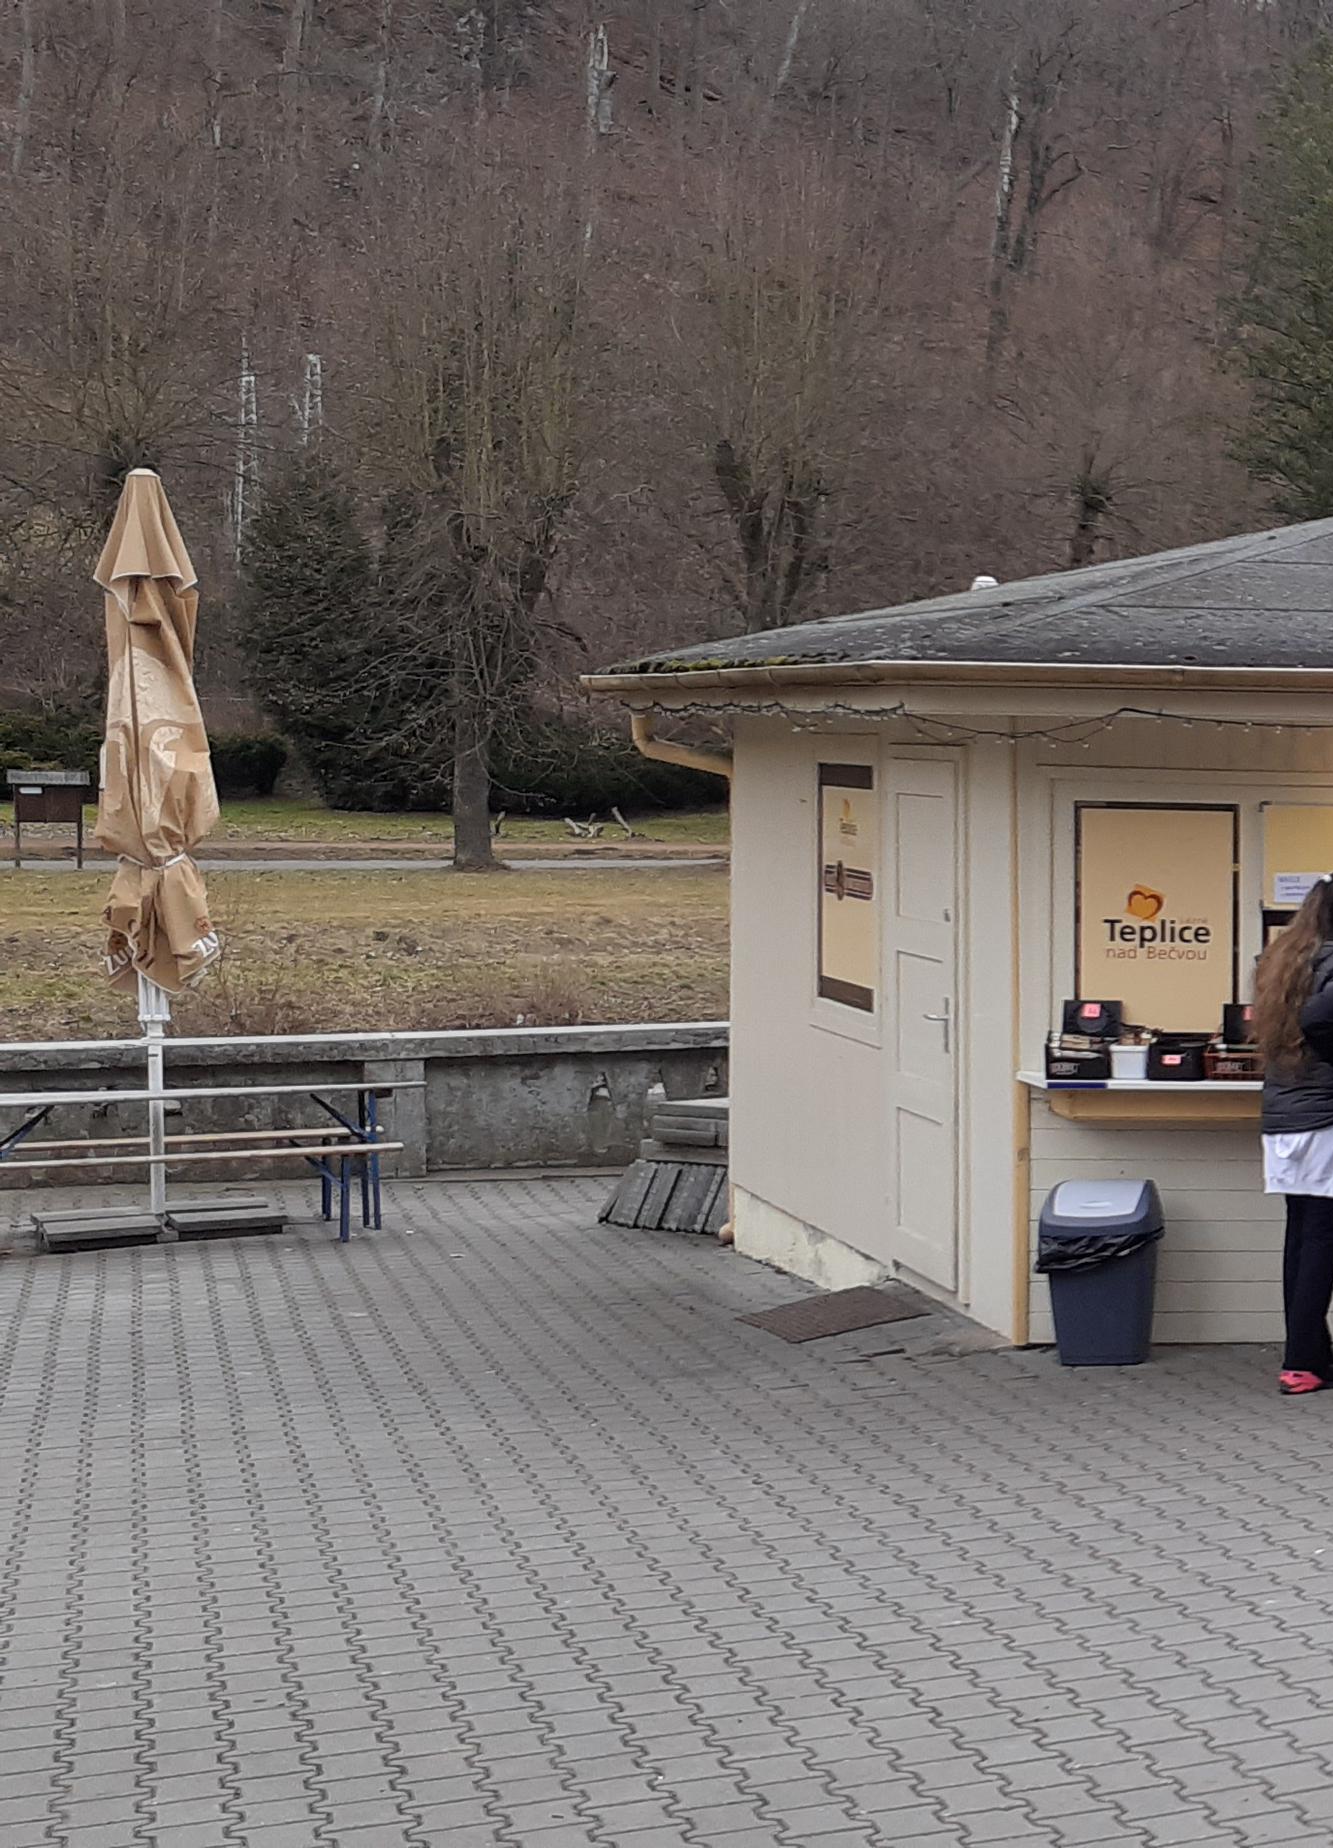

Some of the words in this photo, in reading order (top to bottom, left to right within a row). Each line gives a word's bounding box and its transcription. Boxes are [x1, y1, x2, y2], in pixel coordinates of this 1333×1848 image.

[1103, 918, 1211, 949] Teplice
[1106, 946, 1137, 960] nad
[1147, 945, 1208, 960] Bečvou
